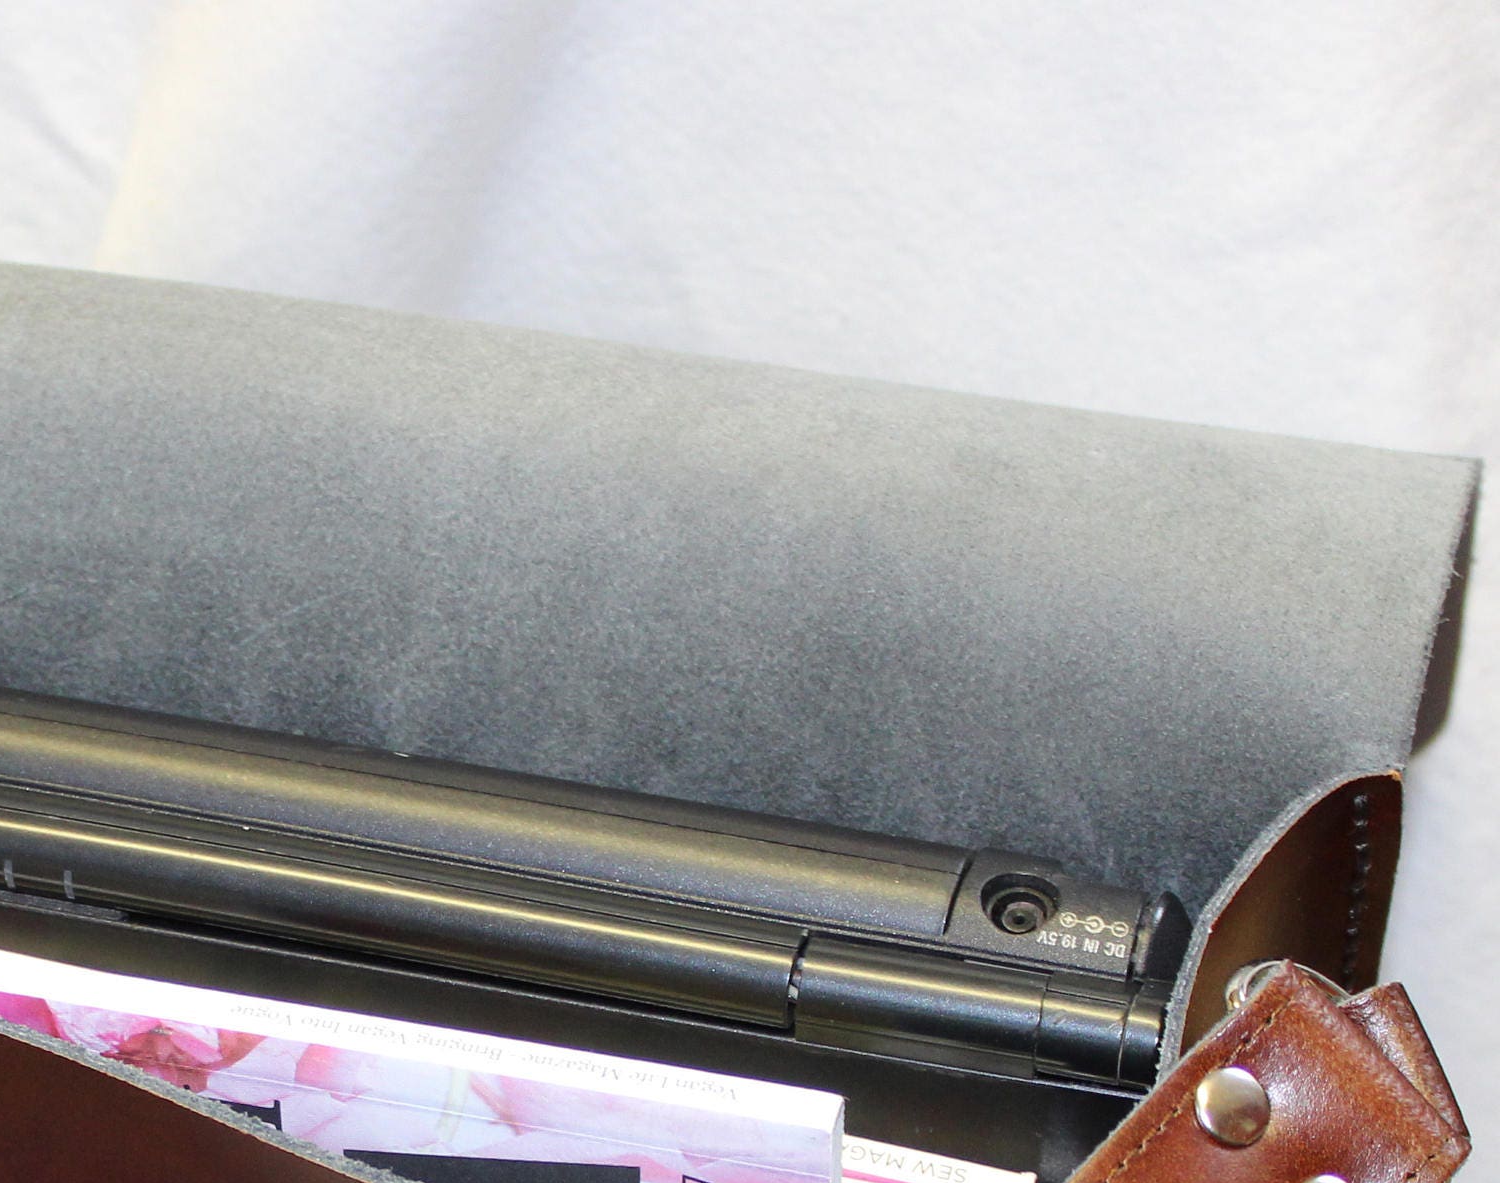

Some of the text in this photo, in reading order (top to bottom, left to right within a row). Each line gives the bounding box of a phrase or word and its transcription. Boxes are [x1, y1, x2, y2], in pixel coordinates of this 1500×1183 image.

[1036, 930, 1127, 959] DC IN 19.5V
[230, 1004, 293, 1027] Vogue
[301, 1016, 342, 1034] Into
[347, 1023, 407, 1046] Vegan
[417, 1033, 503, 1062] Bringing
[522, 1053, 621, 1082] Magazine
[628, 1070, 668, 1089] Life
[674, 1079, 738, 1101] Vegan
[842, 1143, 909, 1170] MAG
